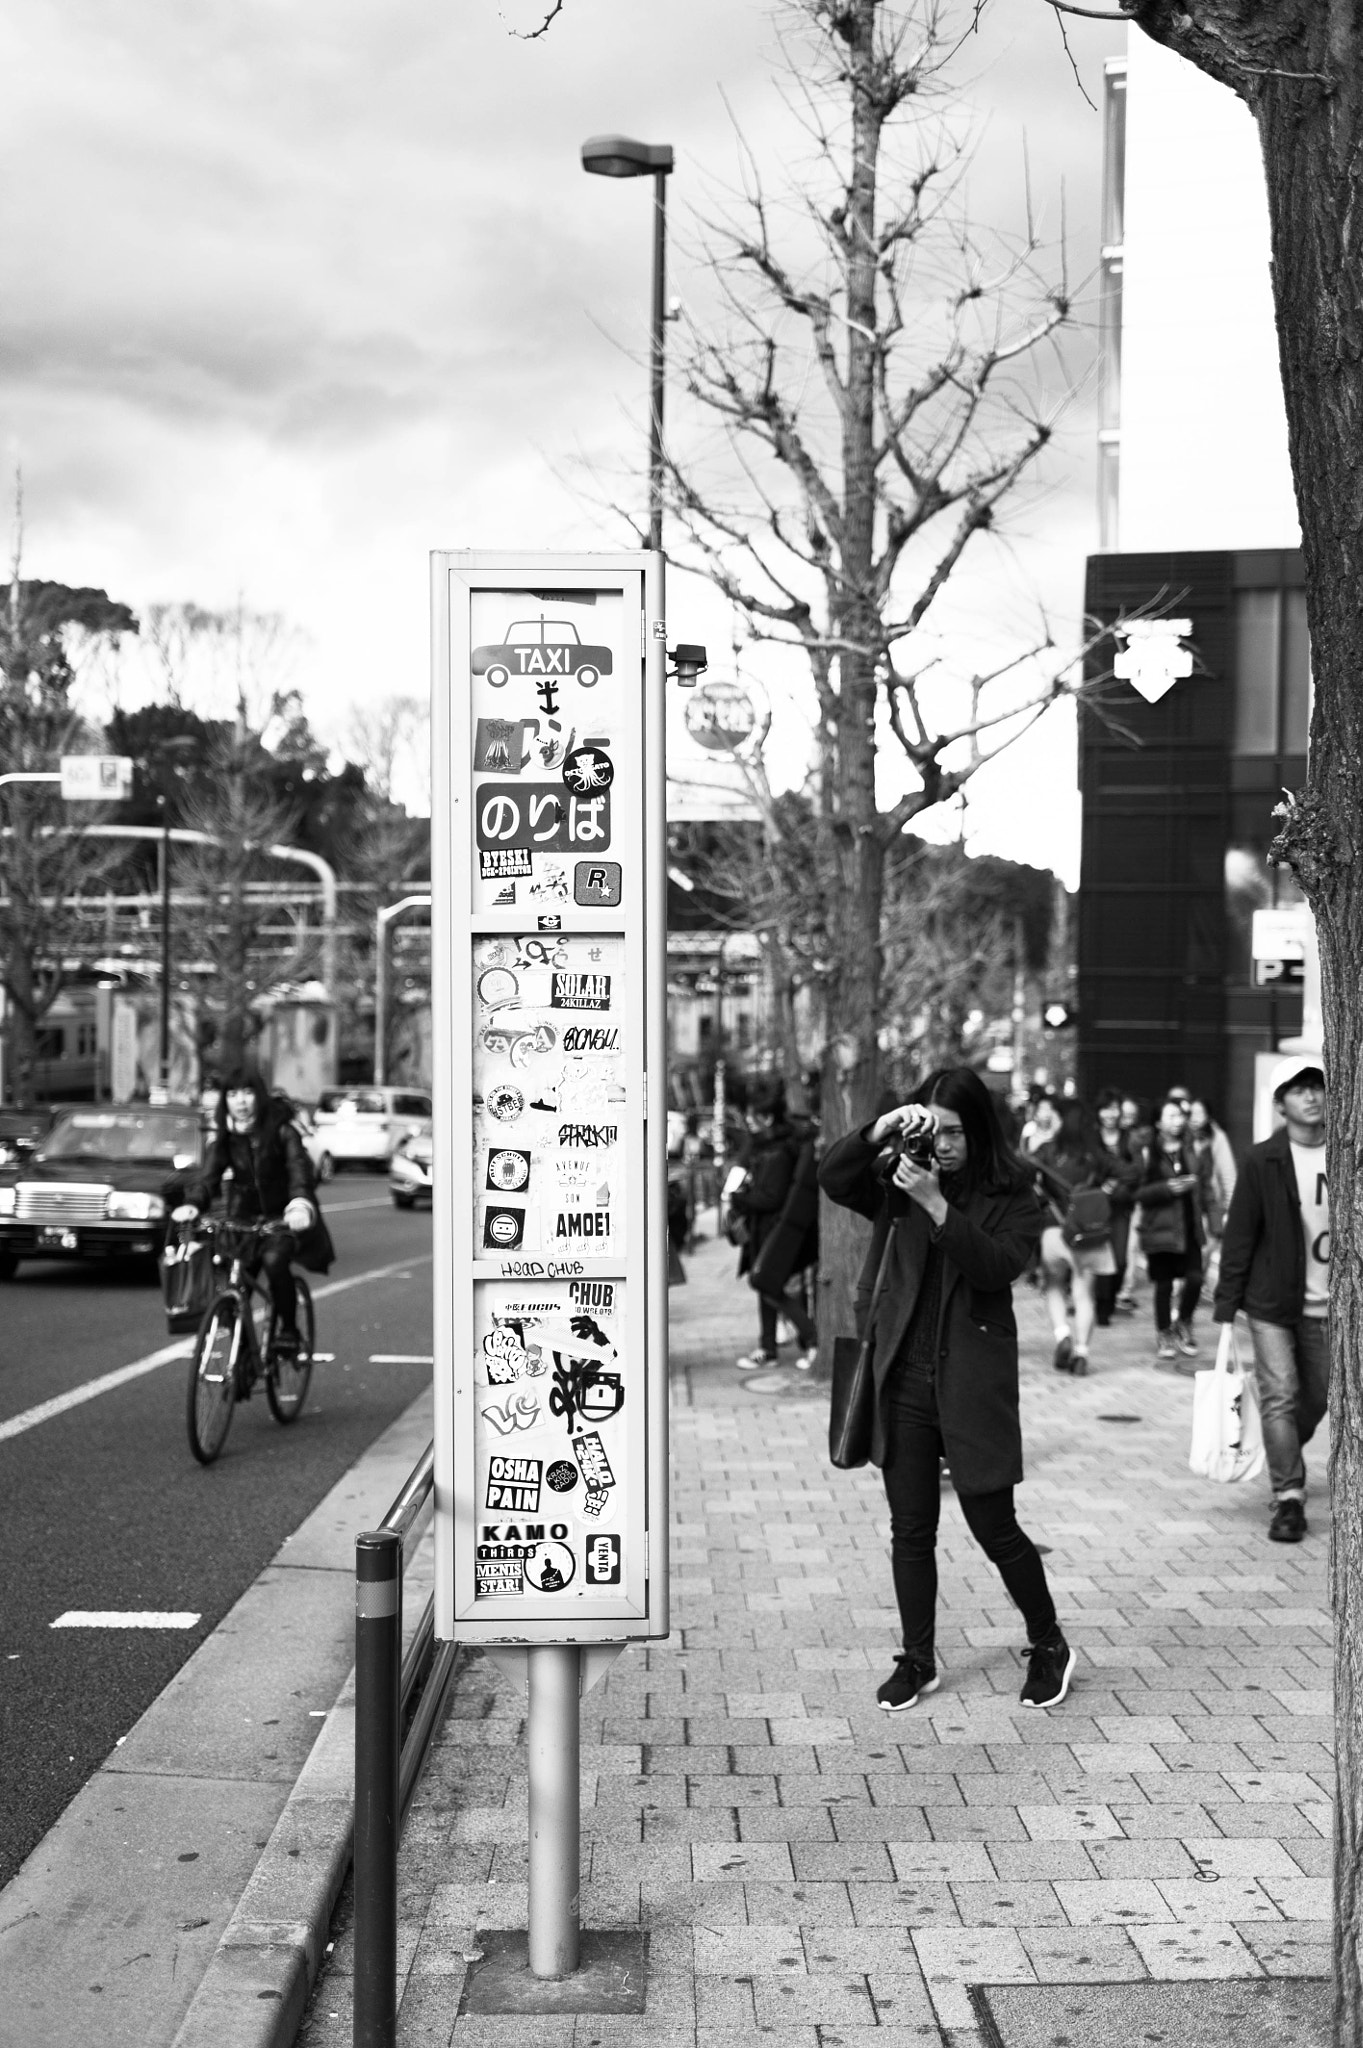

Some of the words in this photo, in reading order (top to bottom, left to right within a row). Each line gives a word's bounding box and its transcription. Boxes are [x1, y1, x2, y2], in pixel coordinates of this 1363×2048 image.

[514, 648, 570, 673] TAXI
[482, 794, 606, 841] のりば
[547, 1261, 584, 1278] CHUB
[491, 1458, 539, 1482] OSHA
[546, 1461, 569, 1482] KRAZY
[554, 1471, 577, 1491] RADIO
[488, 1486, 538, 1511] PAIN
[483, 1523, 568, 1541] KAMO
[598, 1542, 609, 1574] YENTA
[480, 1579, 520, 1592] STAR!
